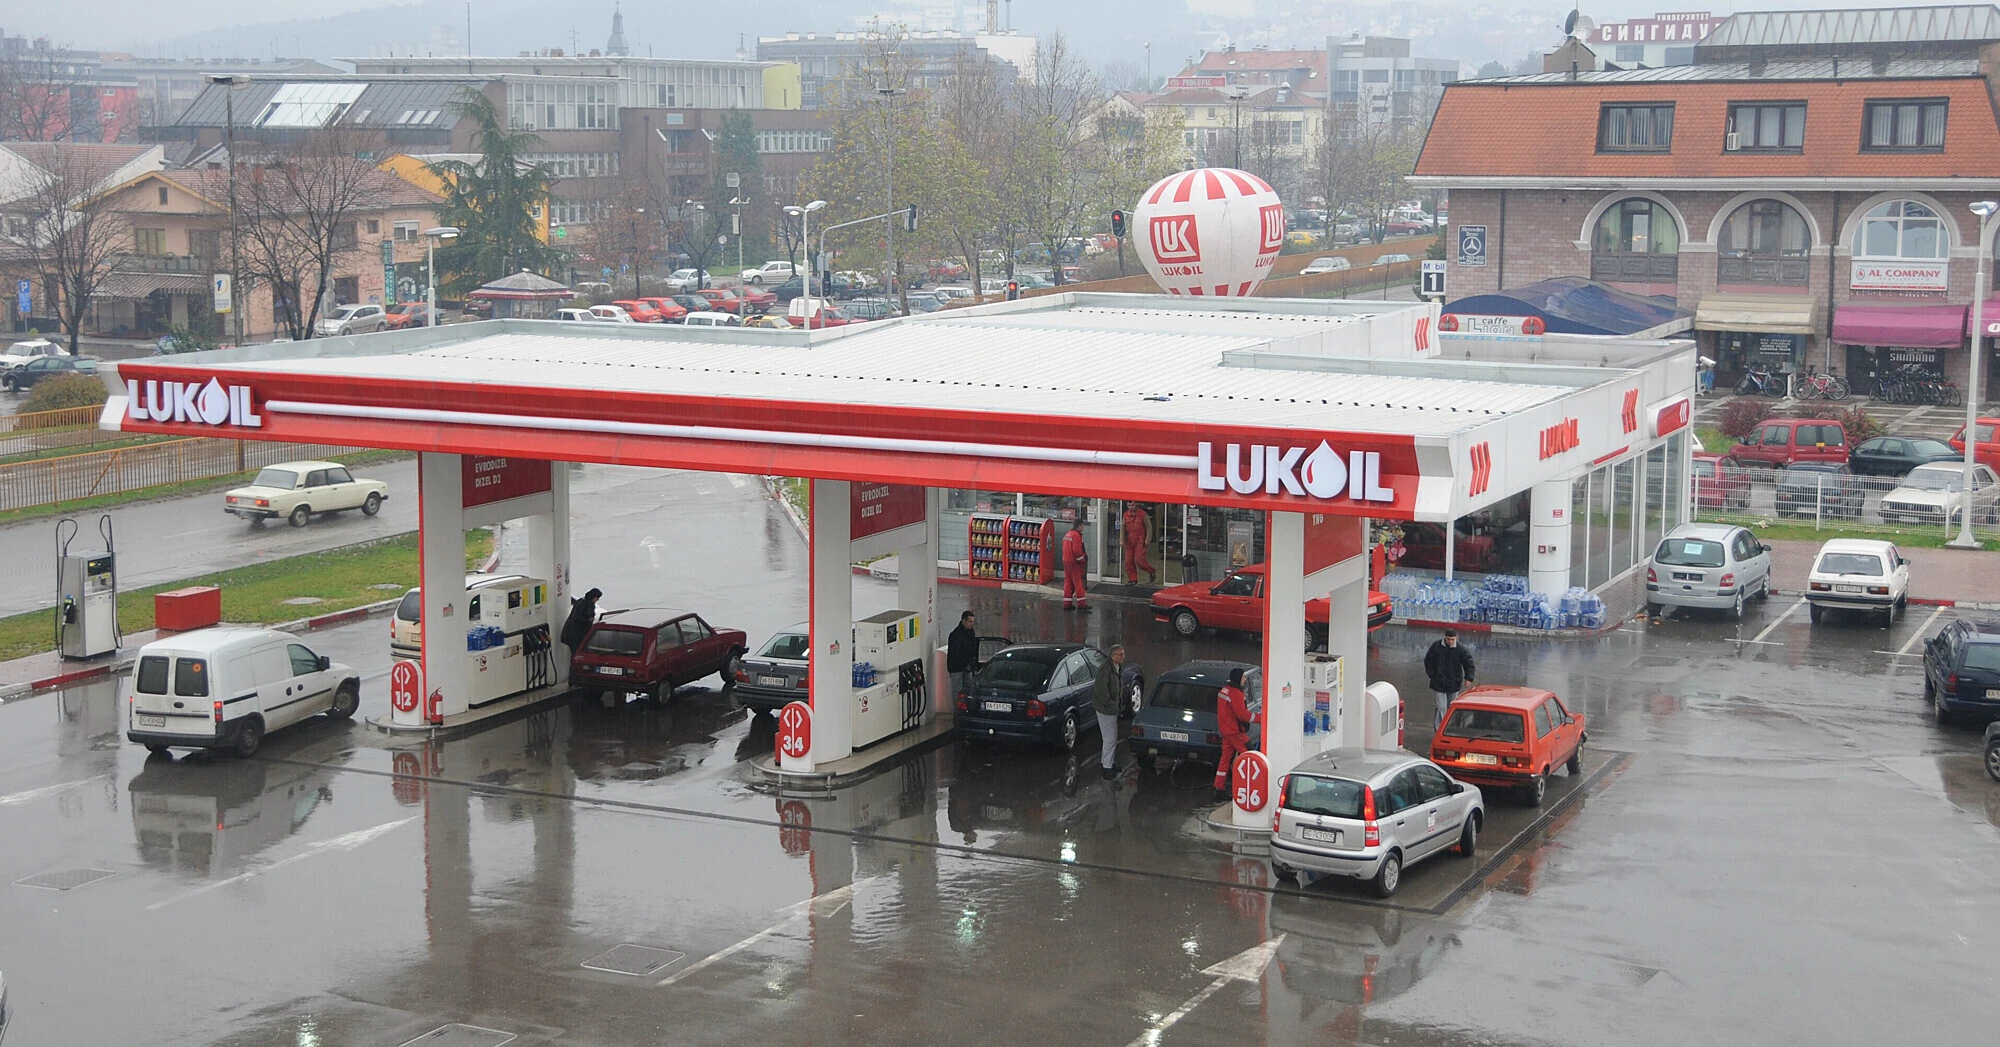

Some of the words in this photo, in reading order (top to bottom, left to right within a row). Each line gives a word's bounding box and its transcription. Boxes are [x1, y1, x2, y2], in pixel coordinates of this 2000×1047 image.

[1160, 265, 1203, 276] LUKOIL
[1868, 269, 1882, 277] AL
[1885, 269, 1940, 278] COMPANY
[1429, 273, 1437, 291] 1
[1481, 317, 1508, 325] caffe
[1889, 352, 1935, 363] SHIMANO
[127, 376, 262, 427] LUKOIL
[1539, 416, 1580, 461] LUKOIL
[475, 458, 507, 473] EVRODIZEL
[1198, 438, 1394, 502] LUKOIL
[475, 475, 491, 488] DIZEL
[493, 474, 501, 484] D2
[861, 485, 889, 502] EVRODIZEL
[861, 504, 875, 518] DIZEL
[395, 691, 401, 705] 1
[404, 691, 411, 706] 2
[783, 735, 792, 750] 3
[795, 736, 804, 752] 4
[1236, 787, 1247, 804] 5
[1249, 789, 1260, 806] 6
